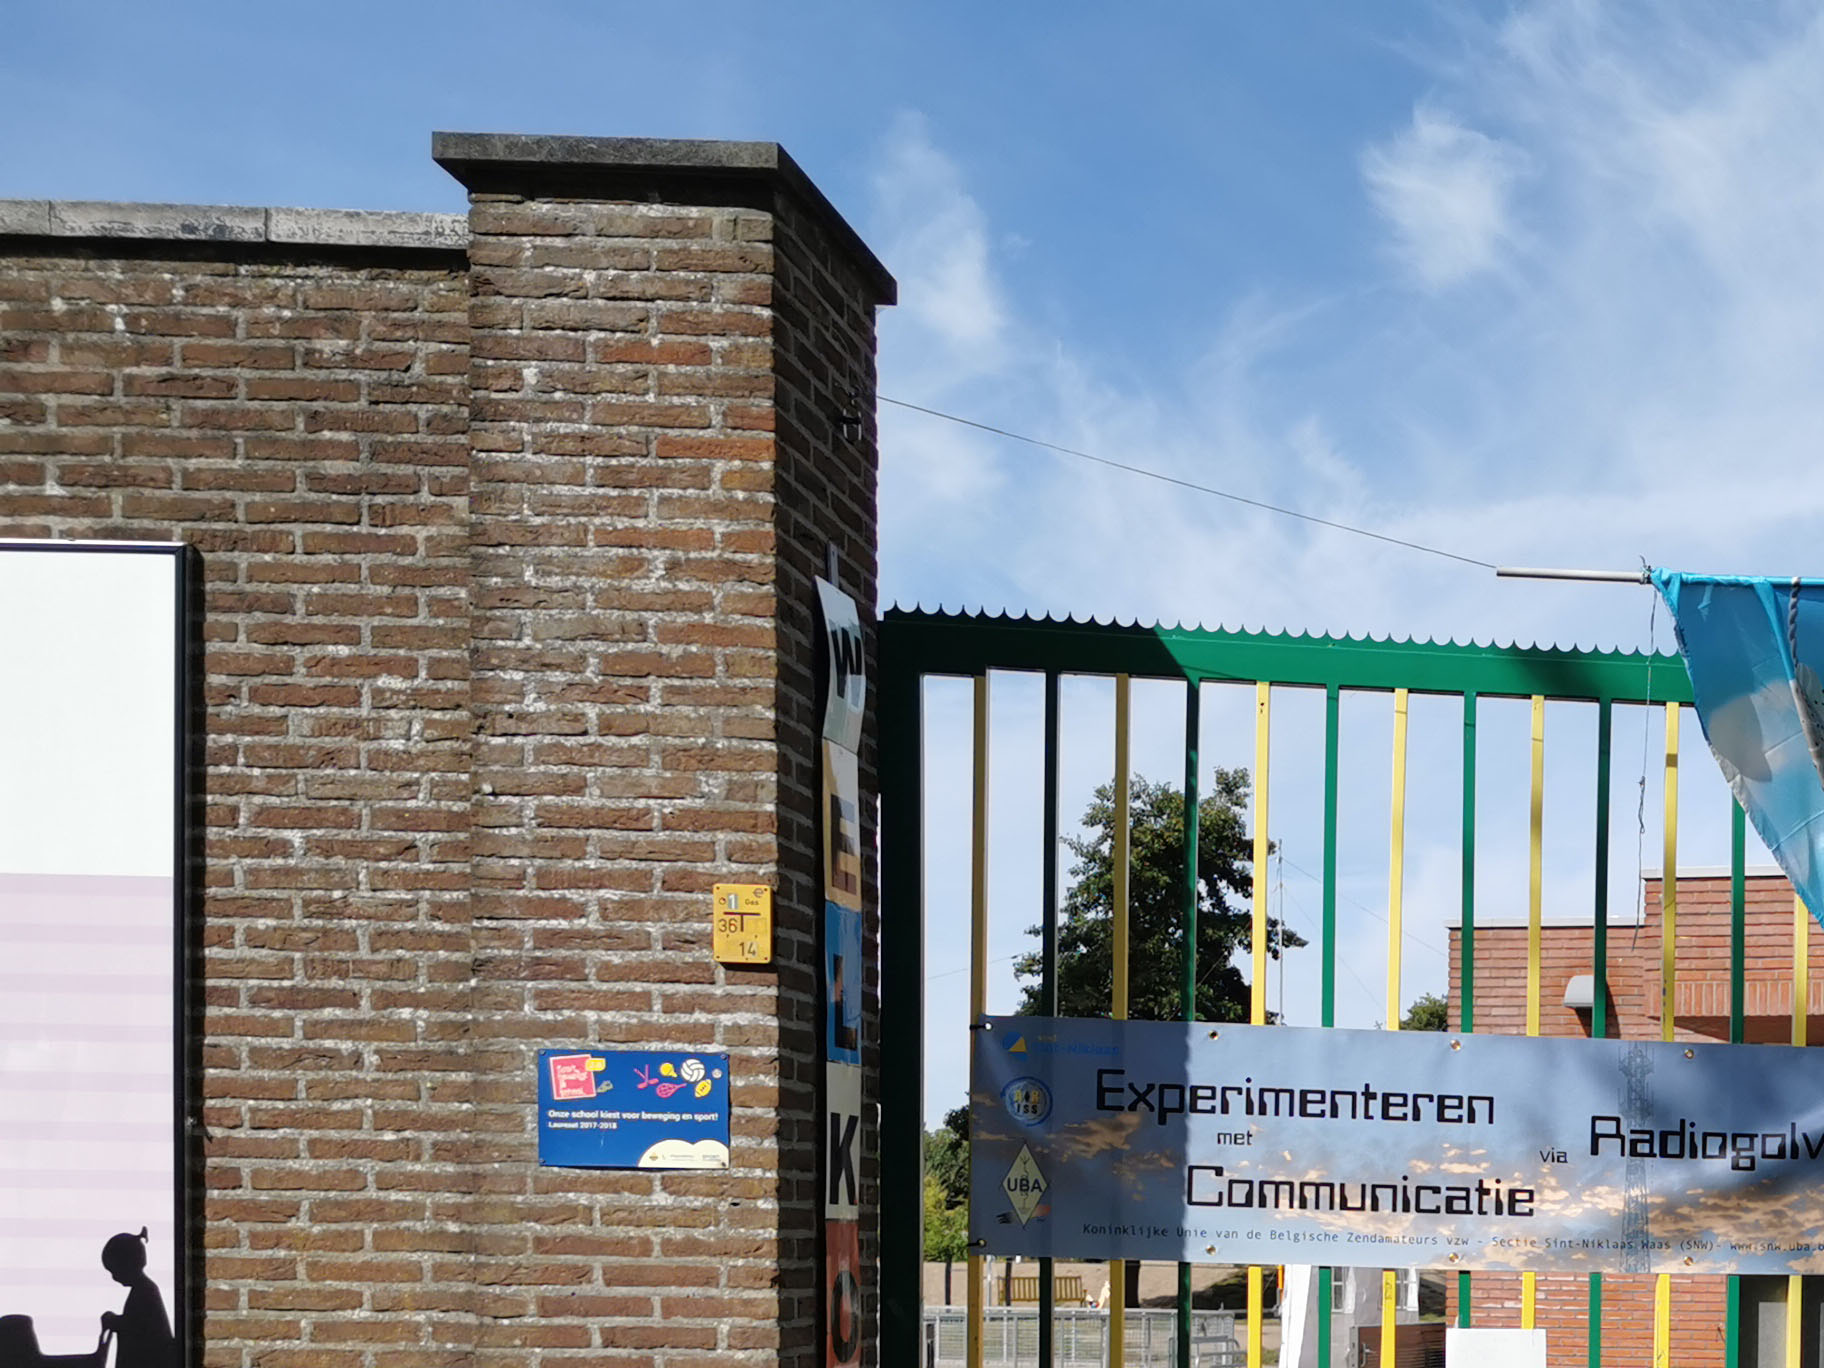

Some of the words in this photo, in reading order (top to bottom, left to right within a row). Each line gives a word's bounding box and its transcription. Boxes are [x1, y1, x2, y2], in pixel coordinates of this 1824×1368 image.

[719, 918, 738, 933] 36
[1096, 1068, 1495, 1126] Experimenteren
[548, 1110, 570, 1118] Onze
[571, 1110, 599, 1118] school
[600, 1110, 621, 1119] kiest
[641, 1111, 681, 1122] beweging
[694, 1112, 719, 1122] sport!
[1016, 1104, 1039, 1114] ISS
[580, 1122, 618, 1130] 2017-2018
[1217, 1130, 1253, 1146] met
[1539, 1147, 1568, 1164] via
[1007, 1177, 1043, 1193] UBA
[1187, 1165, 1535, 1217] Communicatie
[1082, 1223, 1169, 1238] Koninklijke
[1176, 1227, 1208, 1239] Unie
[1216, 1230, 1239, 1239] van
[1246, 1230, 1262, 1240] de
[1270, 1229, 1339, 1242] Belgische
[1347, 1232, 1438, 1246] Zendamateurs
[1446, 1237, 1469, 1246] vzw
[1492, 1236, 1538, 1248] Sectie
[1545, 1238, 1633, 1250] Sint-Niklaas
[1640, 1239, 1671, 1250] Waas
